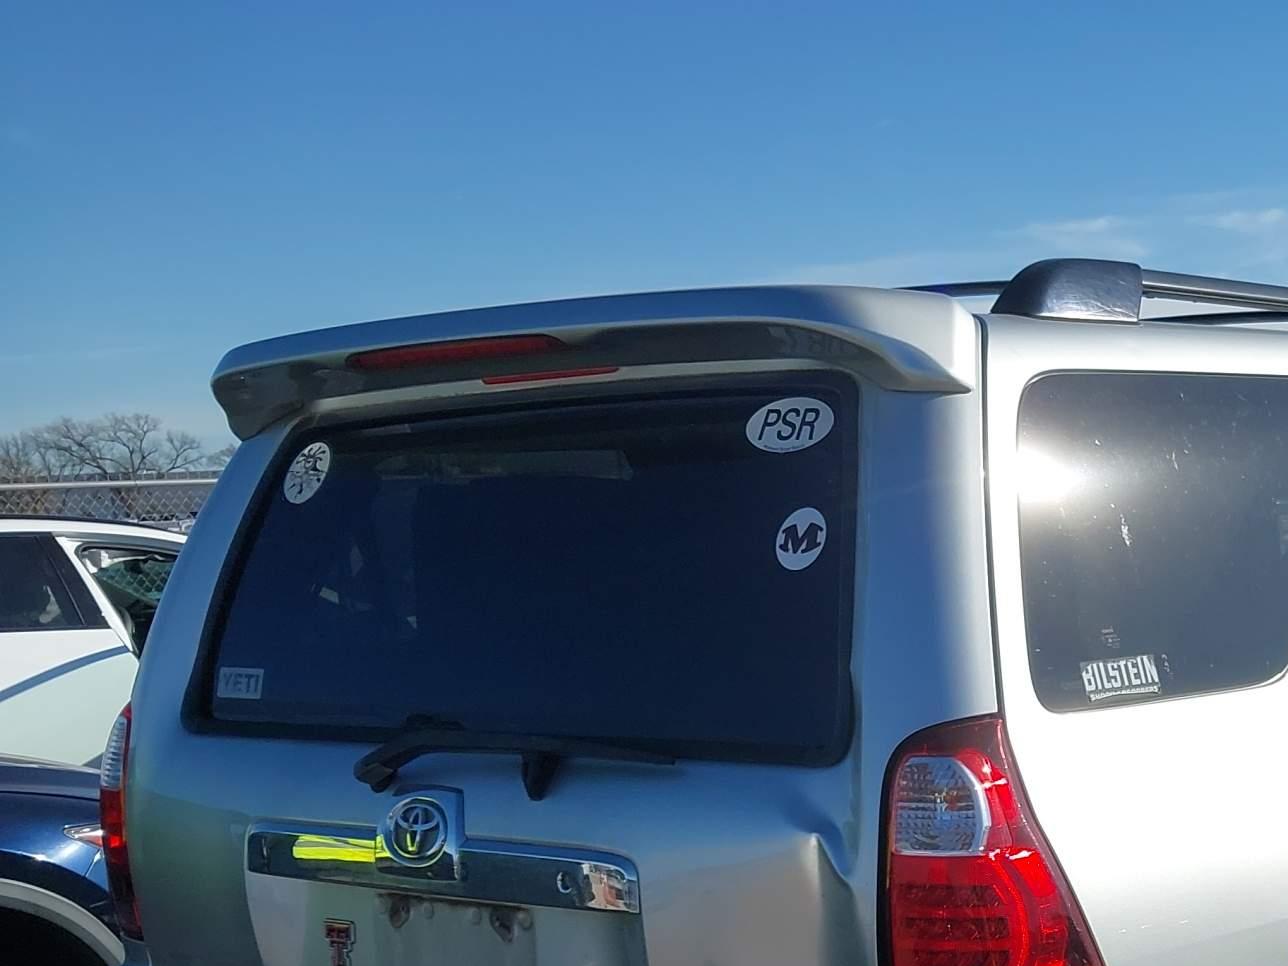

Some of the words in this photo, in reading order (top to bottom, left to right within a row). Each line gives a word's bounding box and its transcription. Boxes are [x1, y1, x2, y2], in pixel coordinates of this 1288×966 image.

[758, 408, 820, 441] PSR
[779, 522, 824, 554] M
[223, 672, 260, 694] YETI
[1082, 655, 1160, 692] BILSTEIN
